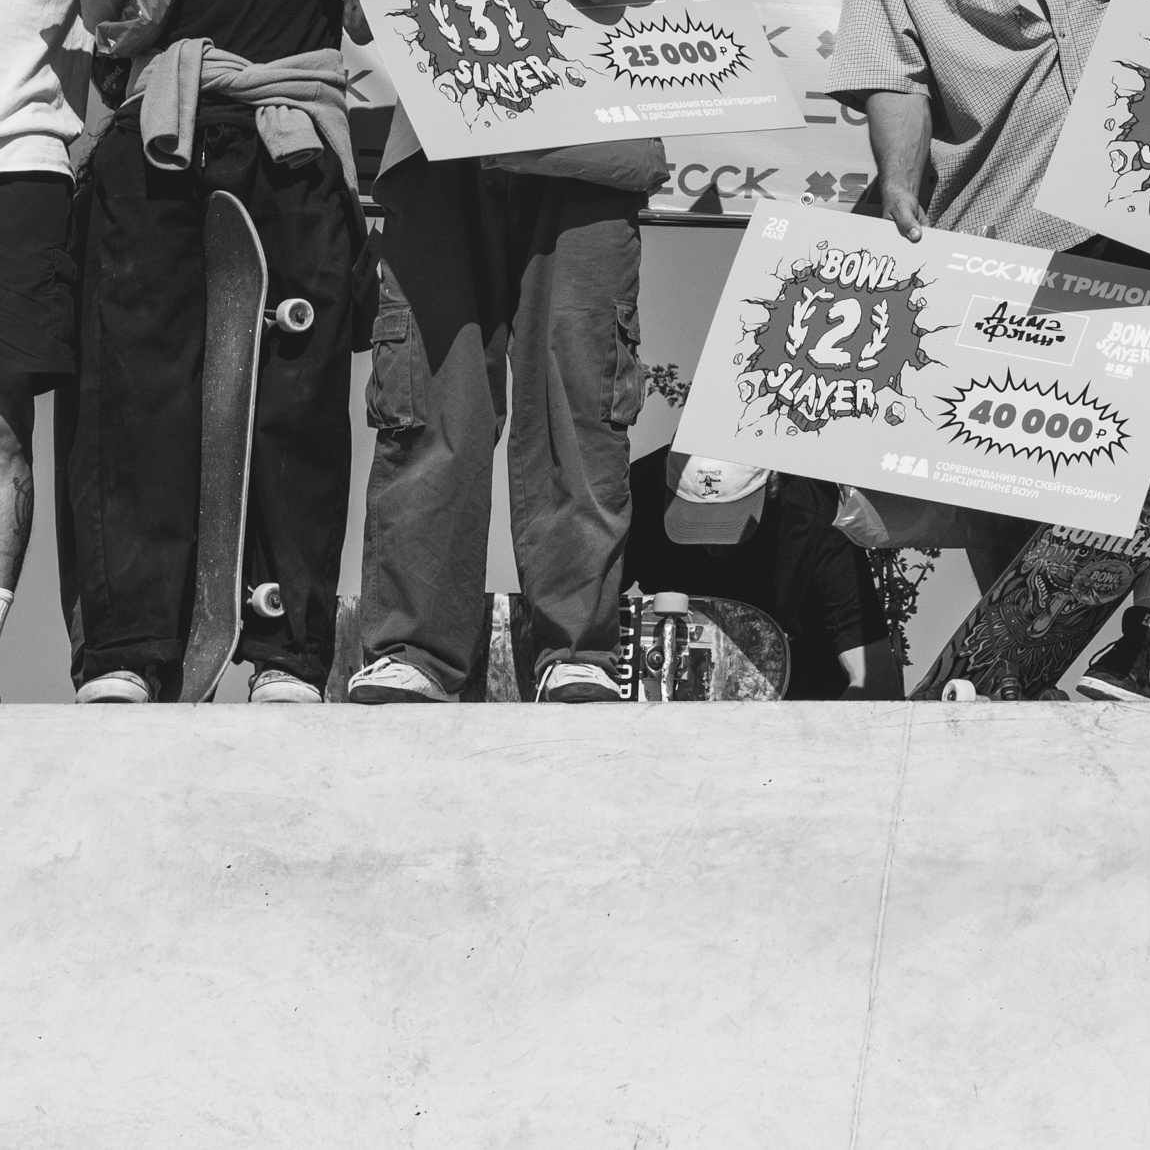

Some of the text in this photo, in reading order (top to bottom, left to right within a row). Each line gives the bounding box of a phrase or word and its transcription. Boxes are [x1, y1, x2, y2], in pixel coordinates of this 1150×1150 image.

[622, 45, 659, 67] 25
[661, 40, 717, 65] 000
[455, 55, 558, 102] SLAYER
[637, 95, 777, 112] СОРЕВНОВАНИЯ ПО СКЕЙТБОРДИНГУ
[641, 108, 724, 121] В ДИСЦИПЛИНЕ БОУЛ
[762, 230, 785, 241] МАЯ
[765, 217, 789, 233] 28
[820, 249, 898, 291] BOWL
[1014, 265, 1061, 289] ЖК
[983, 301, 1063, 331] Дима
[806, 298, 862, 369] 2
[766, 362, 876, 416] SLAYER
[968, 400, 1016, 428] 40
[1022, 409, 1093, 443] 000
[933, 471, 1040, 499] В ДИСЦИПЛИНЕ БОУЛ
[936, 461, 1121, 503] СОРЕВНОВАНИЯ ПО СКЕЙТБОРДИНГУ
